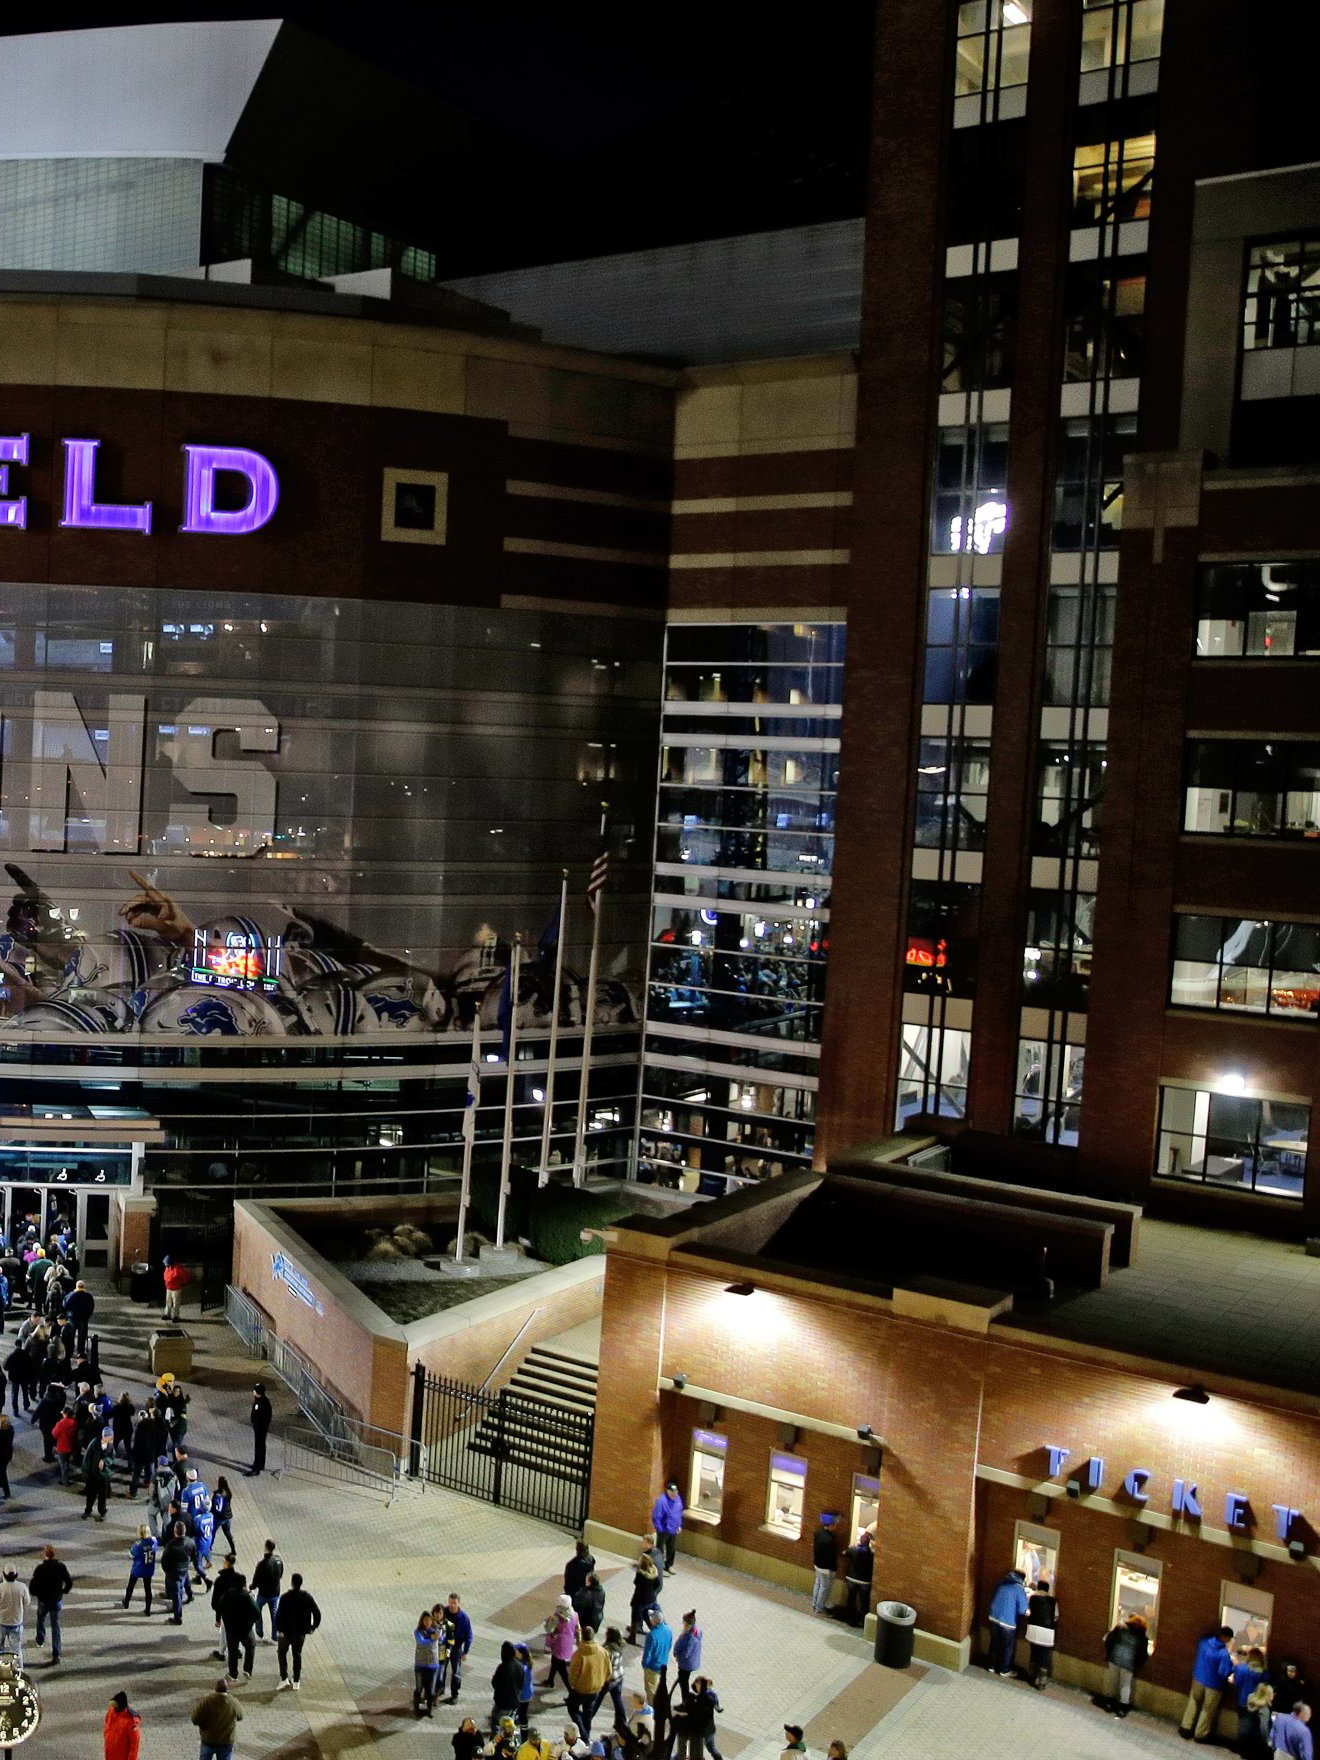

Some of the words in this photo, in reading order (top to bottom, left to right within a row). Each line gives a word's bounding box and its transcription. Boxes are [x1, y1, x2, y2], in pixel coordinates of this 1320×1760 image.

[1044, 1444, 1301, 1541] TICKET
[0, 1685, 10, 1693] 12
[15, 1687, 19, 1697] 1
[22, 1696, 29, 1705] 2
[25, 1707, 32, 1717] 3
[21, 1718, 28, 1728] 4
[0, 1731, 7, 1740] 6
[13, 1728, 19, 1737] 5
